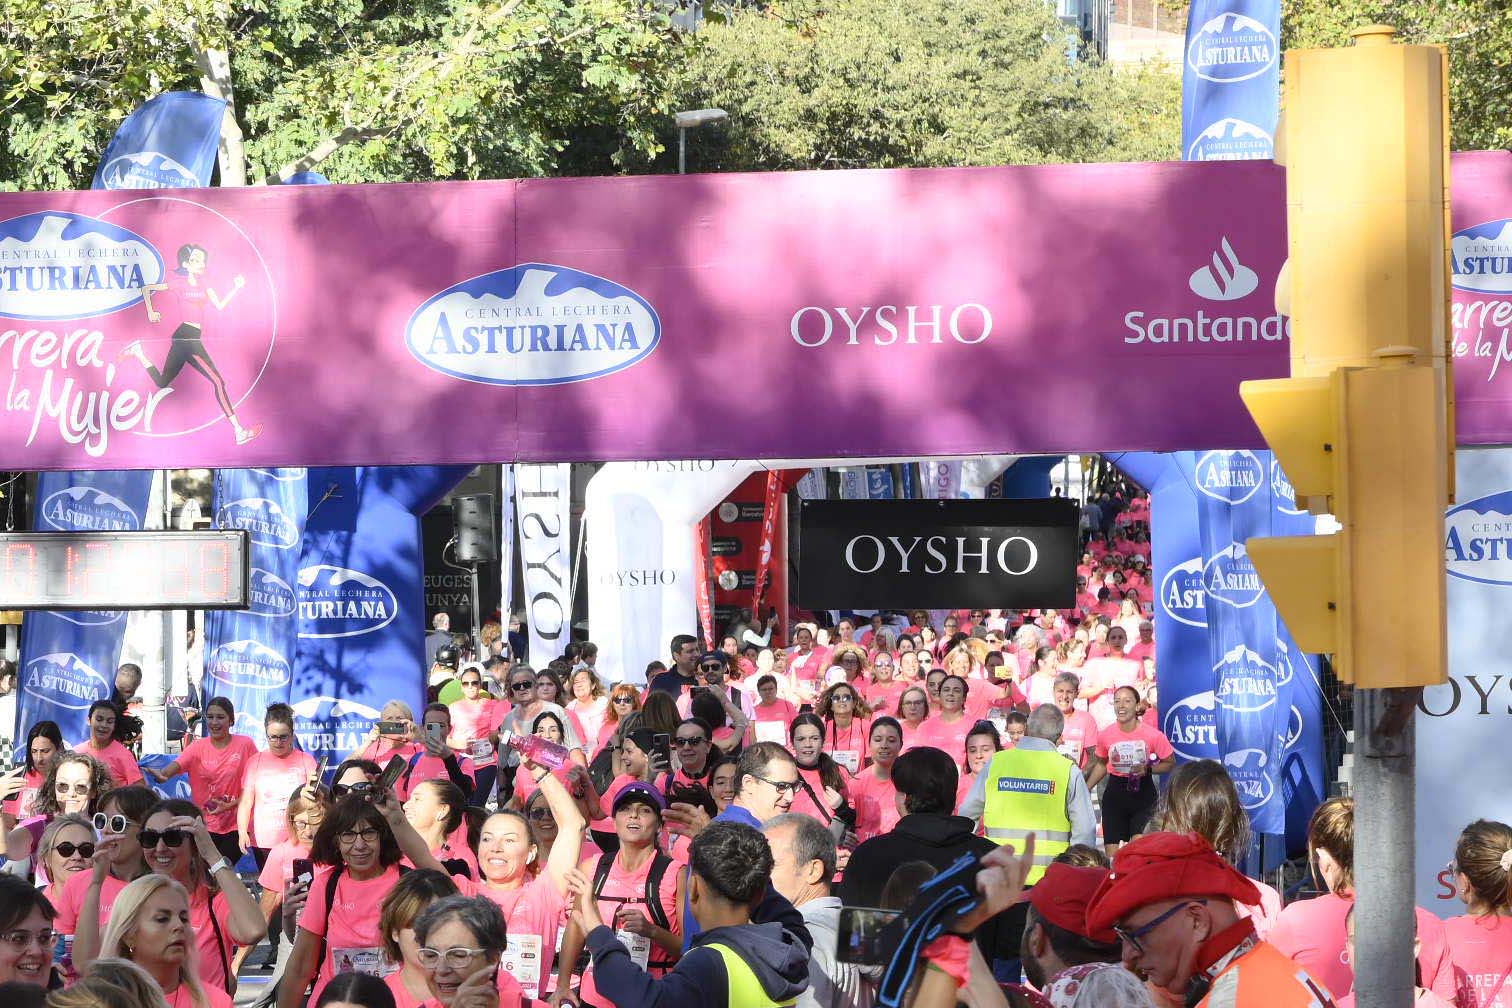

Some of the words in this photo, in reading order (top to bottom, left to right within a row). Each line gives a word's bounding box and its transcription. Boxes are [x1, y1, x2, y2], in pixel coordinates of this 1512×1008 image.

[68, 247, 140, 259] LECHERA
[465, 305, 543, 318] CENTRAL
[551, 304, 632, 318] LECHERA
[790, 303, 994, 348] OYSHO
[426, 311, 640, 355] ASTURIANA
[6, 373, 31, 413] la
[25, 358, 176, 457] Mujer
[845, 534, 1038, 576] OYSHO
[999, 780, 1049, 791] VOLUNTARIS
